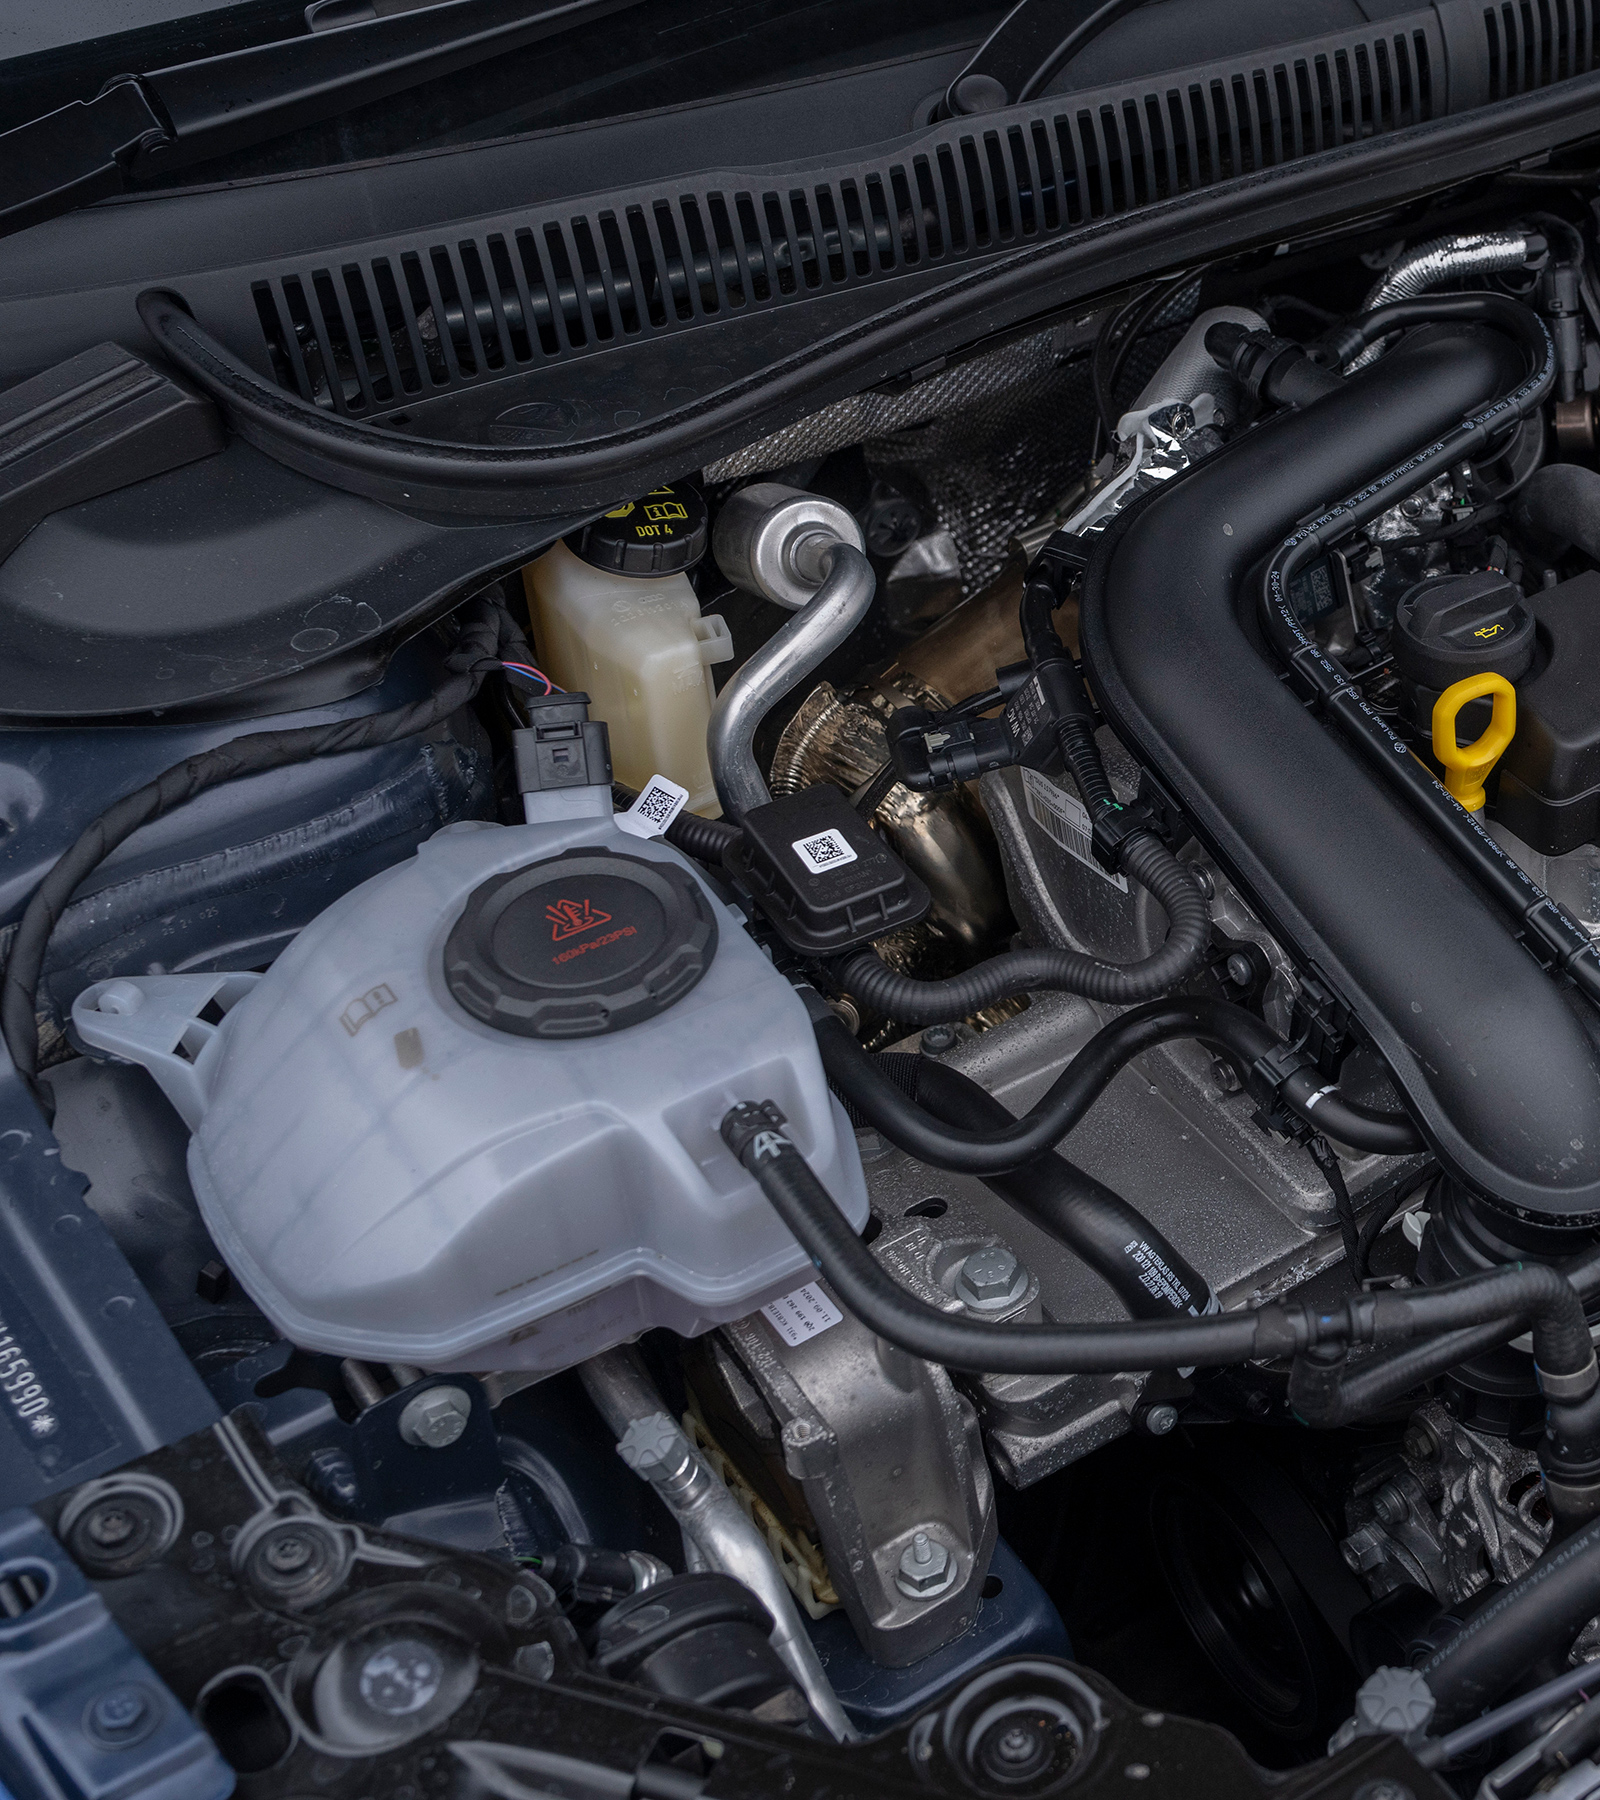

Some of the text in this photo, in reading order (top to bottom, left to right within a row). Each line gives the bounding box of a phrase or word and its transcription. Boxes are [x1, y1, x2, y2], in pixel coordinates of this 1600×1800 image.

[635, 523, 673, 536] DOT 4
[1006, 707, 1020, 737] VW AG
[800, 1288, 830, 1322] 11.09.2024
